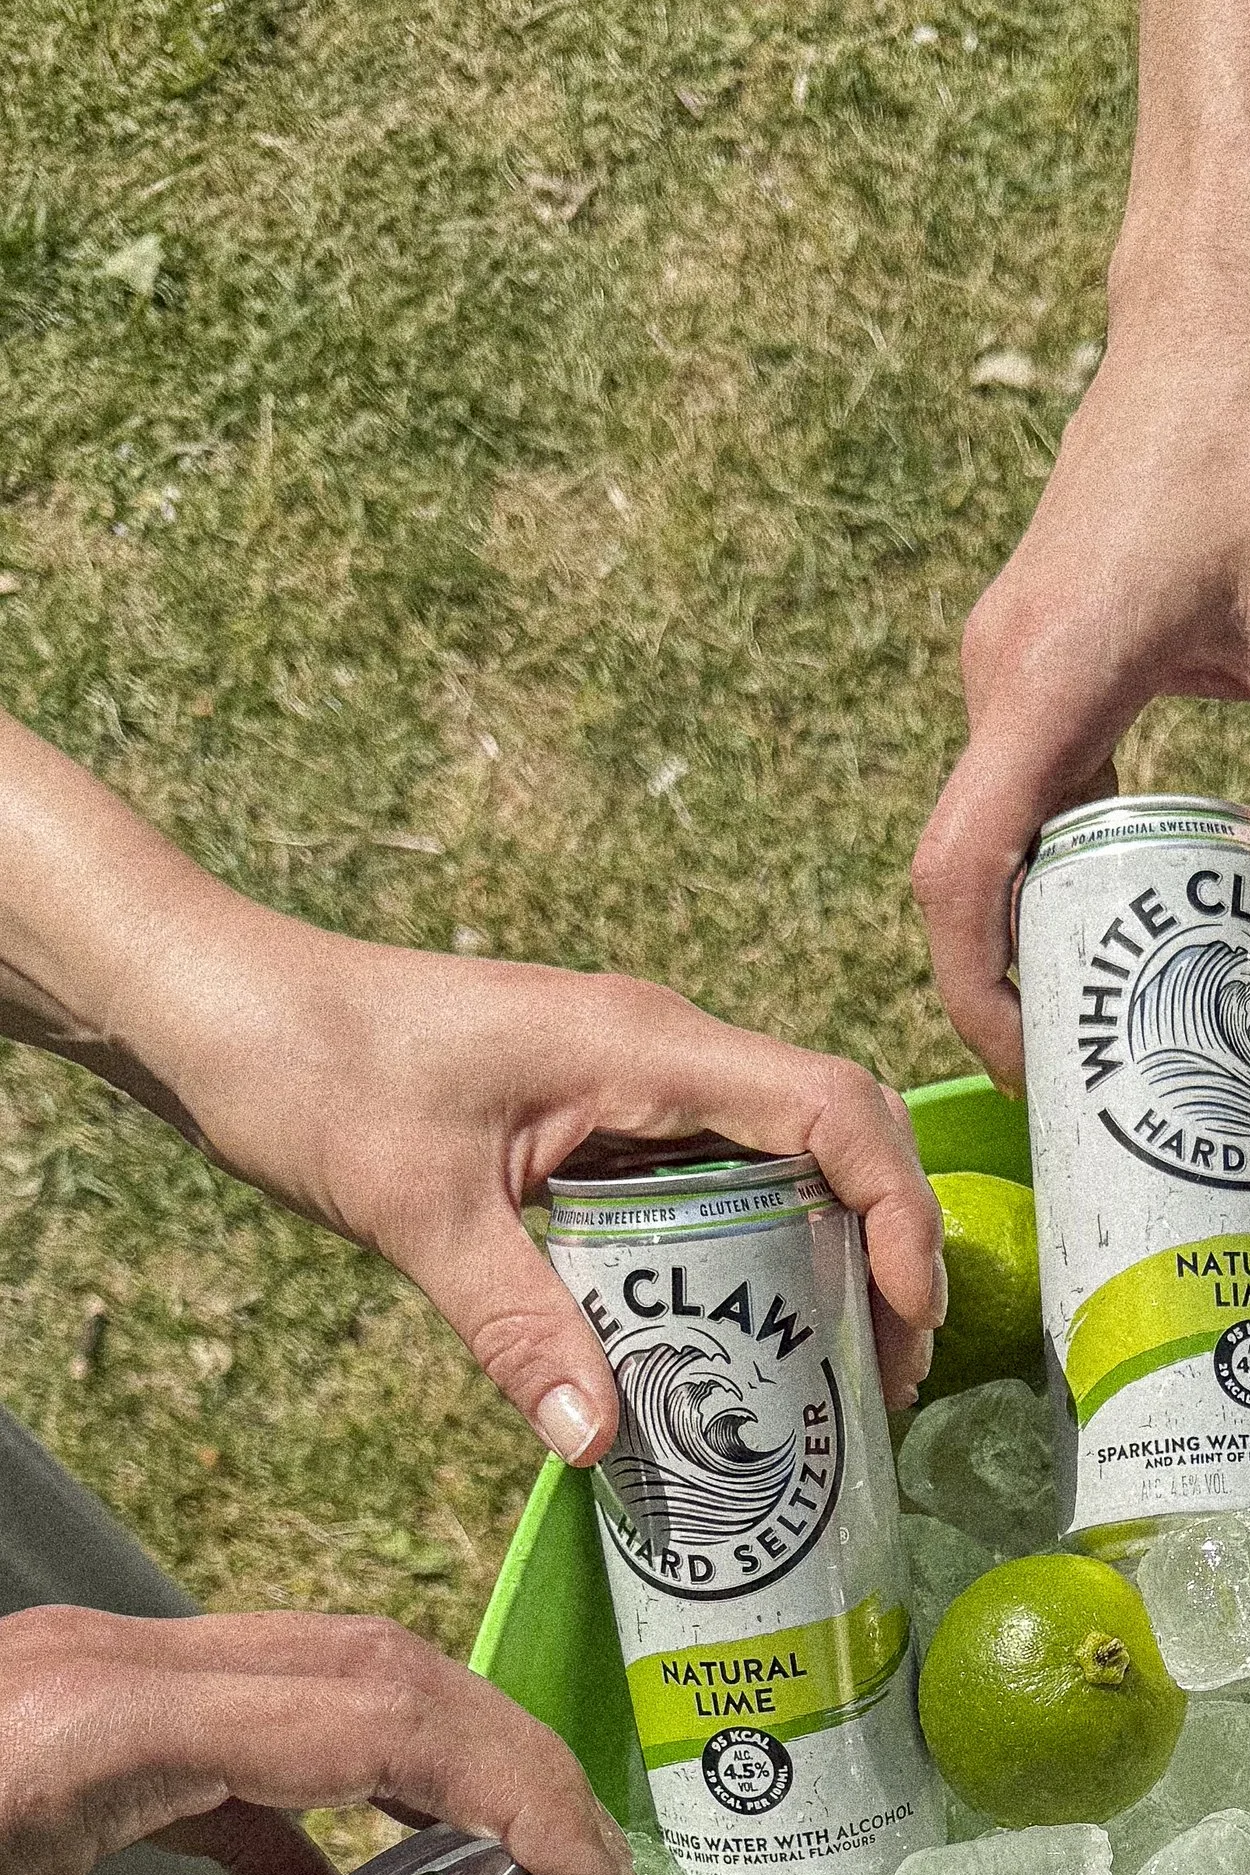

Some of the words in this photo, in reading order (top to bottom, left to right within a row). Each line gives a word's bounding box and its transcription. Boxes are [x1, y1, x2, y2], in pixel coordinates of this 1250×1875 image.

[1087, 825, 1154, 843] ARTIFICIAL
[1078, 887, 1179, 1093] WHITE
[1133, 1107, 1247, 1174] HARD
[598, 1207, 677, 1226] SWEETENERS
[700, 1199, 750, 1218] GLUTEN
[754, 1192, 784, 1210] FREE
[622, 1266, 814, 1361] CLAW
[1226, 1326, 1244, 1345] 95
[1097, 1436, 1201, 1465] SPARKLING
[1144, 1455, 1173, 1470] AND
[1176, 1454, 1187, 1466] A
[1190, 1452, 1223, 1465] HINT
[1226, 1452, 1245, 1463] OF
[617, 1513, 717, 1584] HARD
[732, 1399, 833, 1575] SELTZER
[661, 1652, 808, 1687] NATURAL
[695, 1687, 777, 1718] LIME
[711, 1735, 728, 1752] 95
[729, 1730, 770, 1750] KCAL
[723, 1761, 770, 1780] 4.5%
[714, 1785, 743, 1810] KCAL
[746, 1798, 771, 1811] PER
[664, 1828, 701, 1850] KLING
[704, 1836, 768, 1854] WATER
[773, 1828, 830, 1850] WITH
[836, 1801, 915, 1841] ALCOHOL
[686, 1850, 693, 1861] A
[694, 1851, 720, 1864] HINT
[723, 1855, 740, 1865] OF
[744, 1850, 805, 1865] NATURAL
[809, 1833, 876, 1859] FLAVOURS
